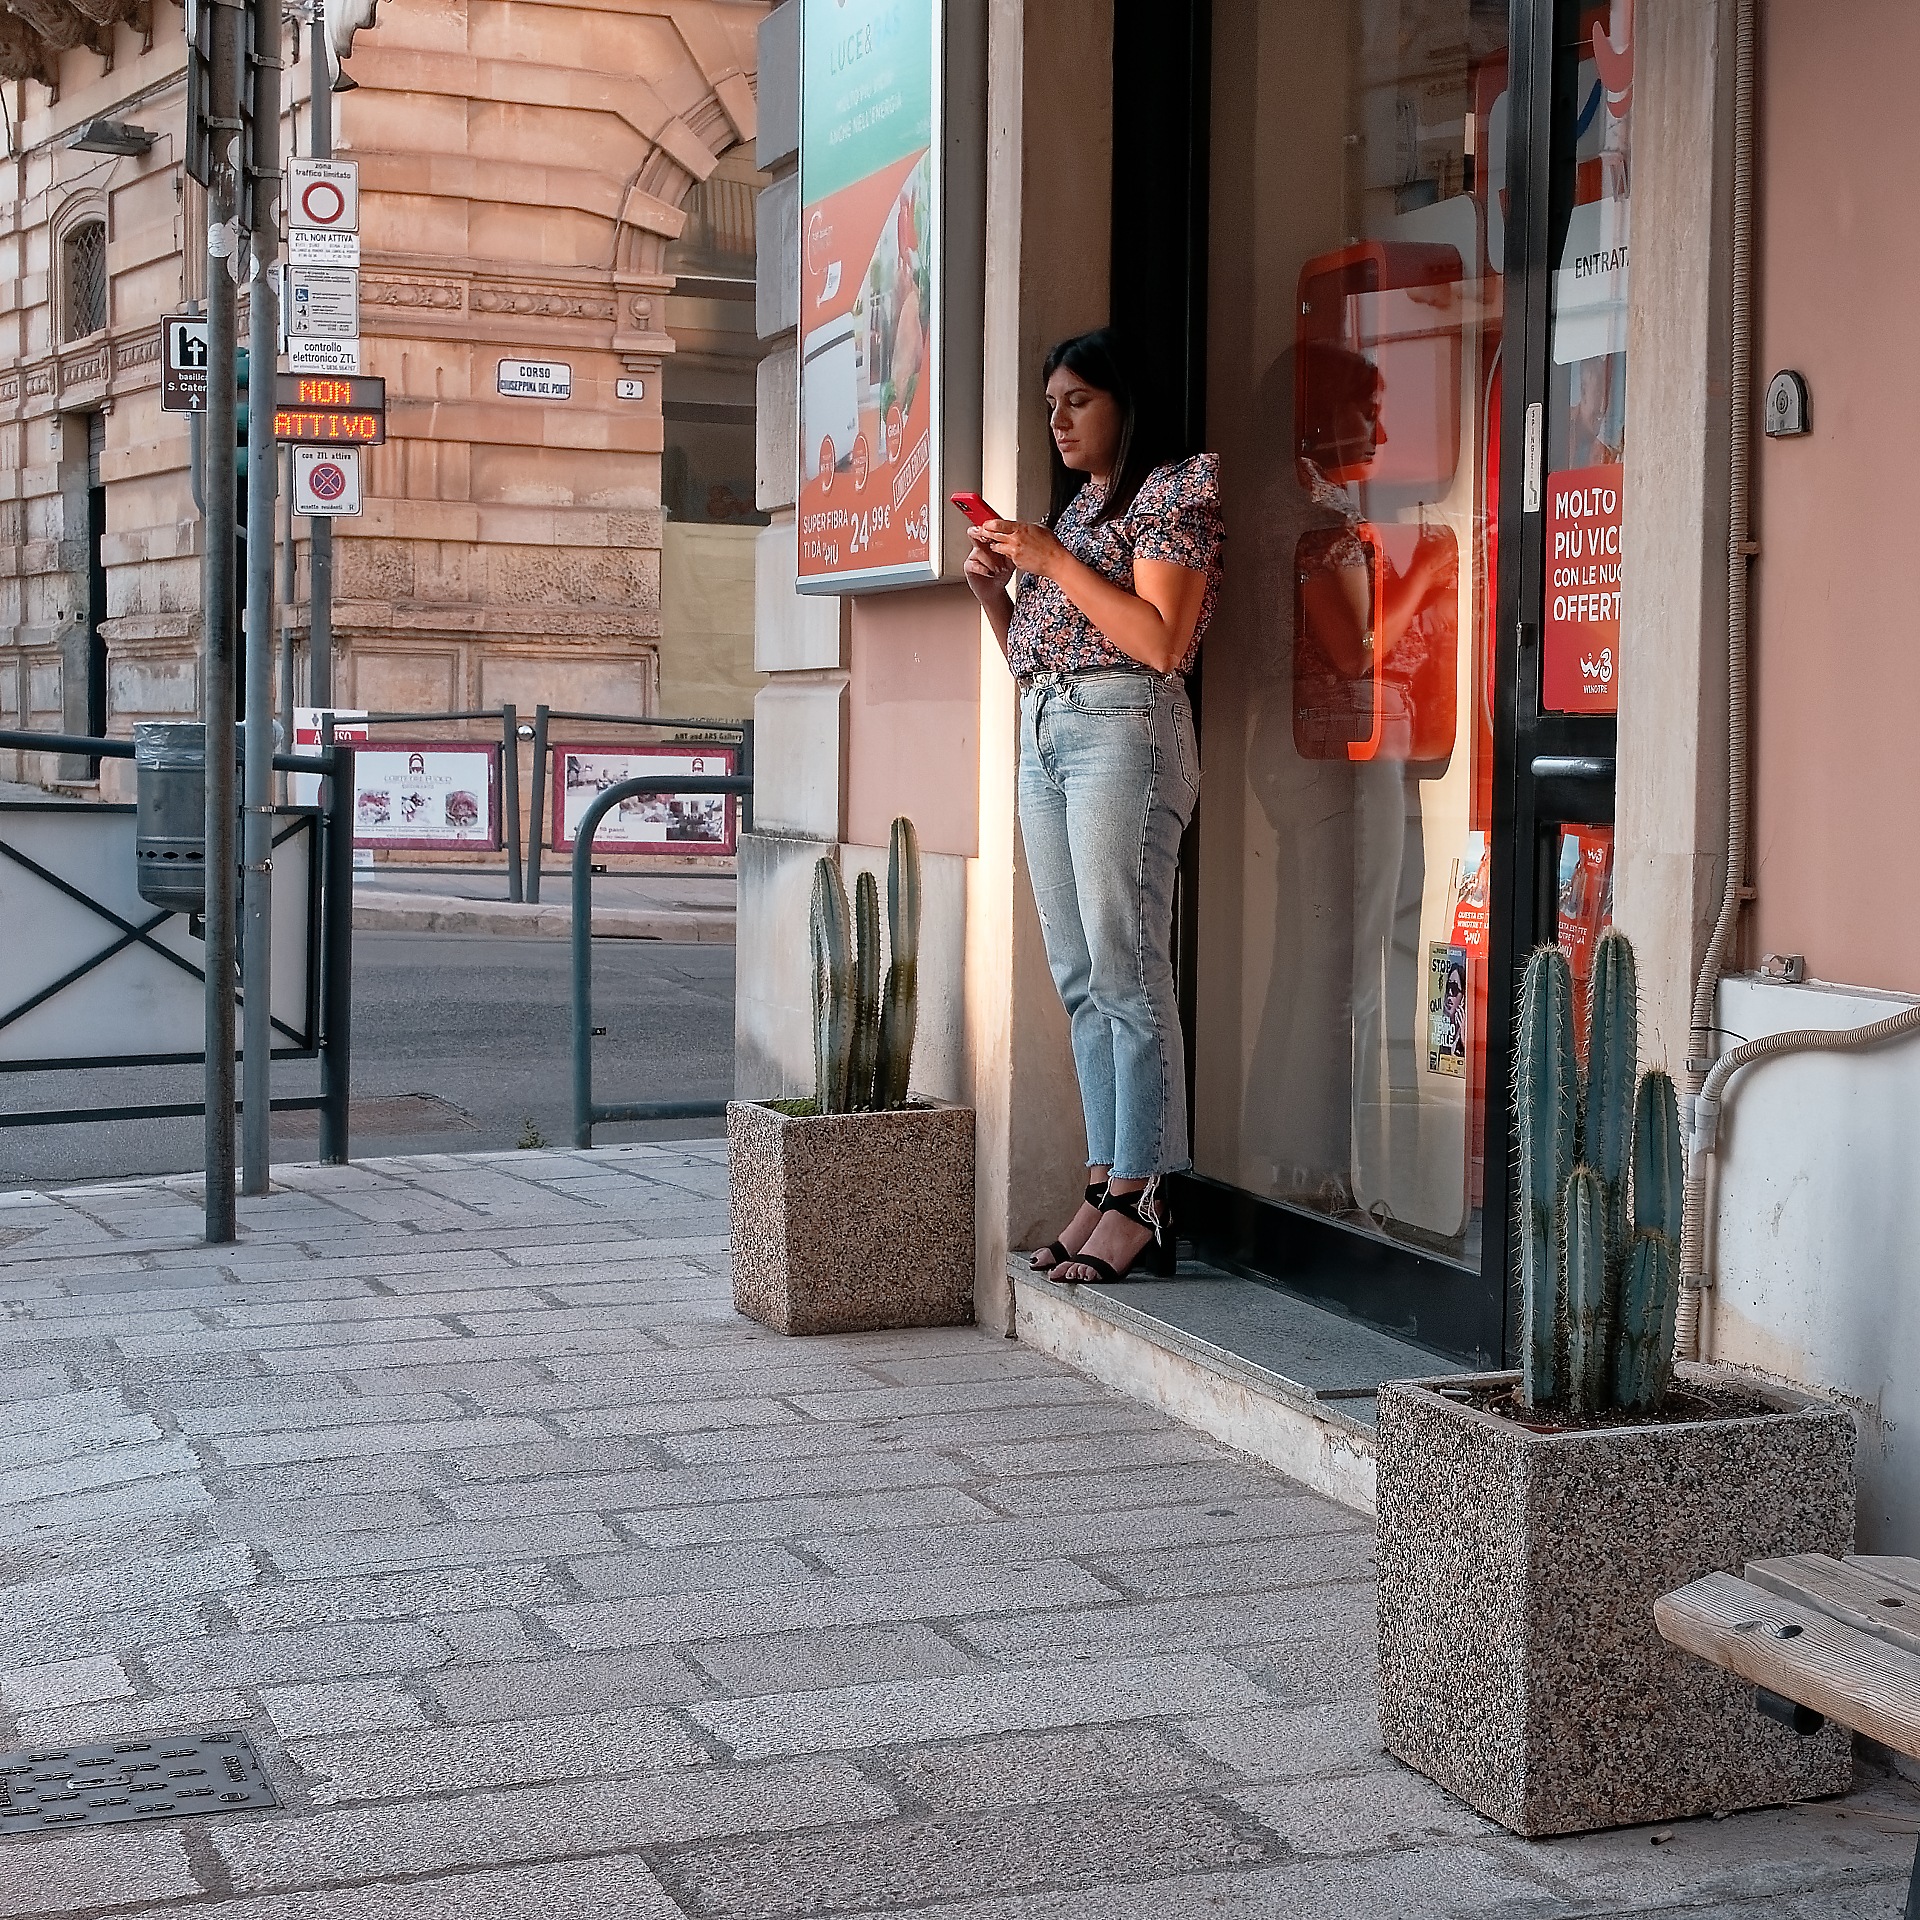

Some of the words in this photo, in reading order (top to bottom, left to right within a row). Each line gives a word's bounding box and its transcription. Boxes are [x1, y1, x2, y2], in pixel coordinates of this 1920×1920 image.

[296, 169, 322, 178] traffico
[324, 171, 351, 179] limitato
[295, 232, 309, 242] ZTL
[311, 233, 327, 242] NON
[328, 235, 353, 243] ATTIVA
[1575, 246, 1630, 279] ENTRAT
[304, 342, 342, 352] controllo
[293, 352, 338, 363] elettronico
[340, 353, 357, 364] ZTL
[178, 372, 207, 381] basilic
[519, 366, 551, 379] CORSO
[167, 381, 178, 391] S.
[299, 380, 351, 404] NON
[500, 380, 537, 394] GIUSEPPINA
[538, 382, 550, 394] DEL
[625, 382, 634, 396] 2
[274, 412, 377, 438] ATTIVO
[1555, 488, 1616, 520] MOLTO
[1554, 521, 1583, 560] PIÙ
[1553, 566, 1579, 588] CON
[1582, 565, 1597, 585] LE
[1431, 958, 1452, 975] STOP
